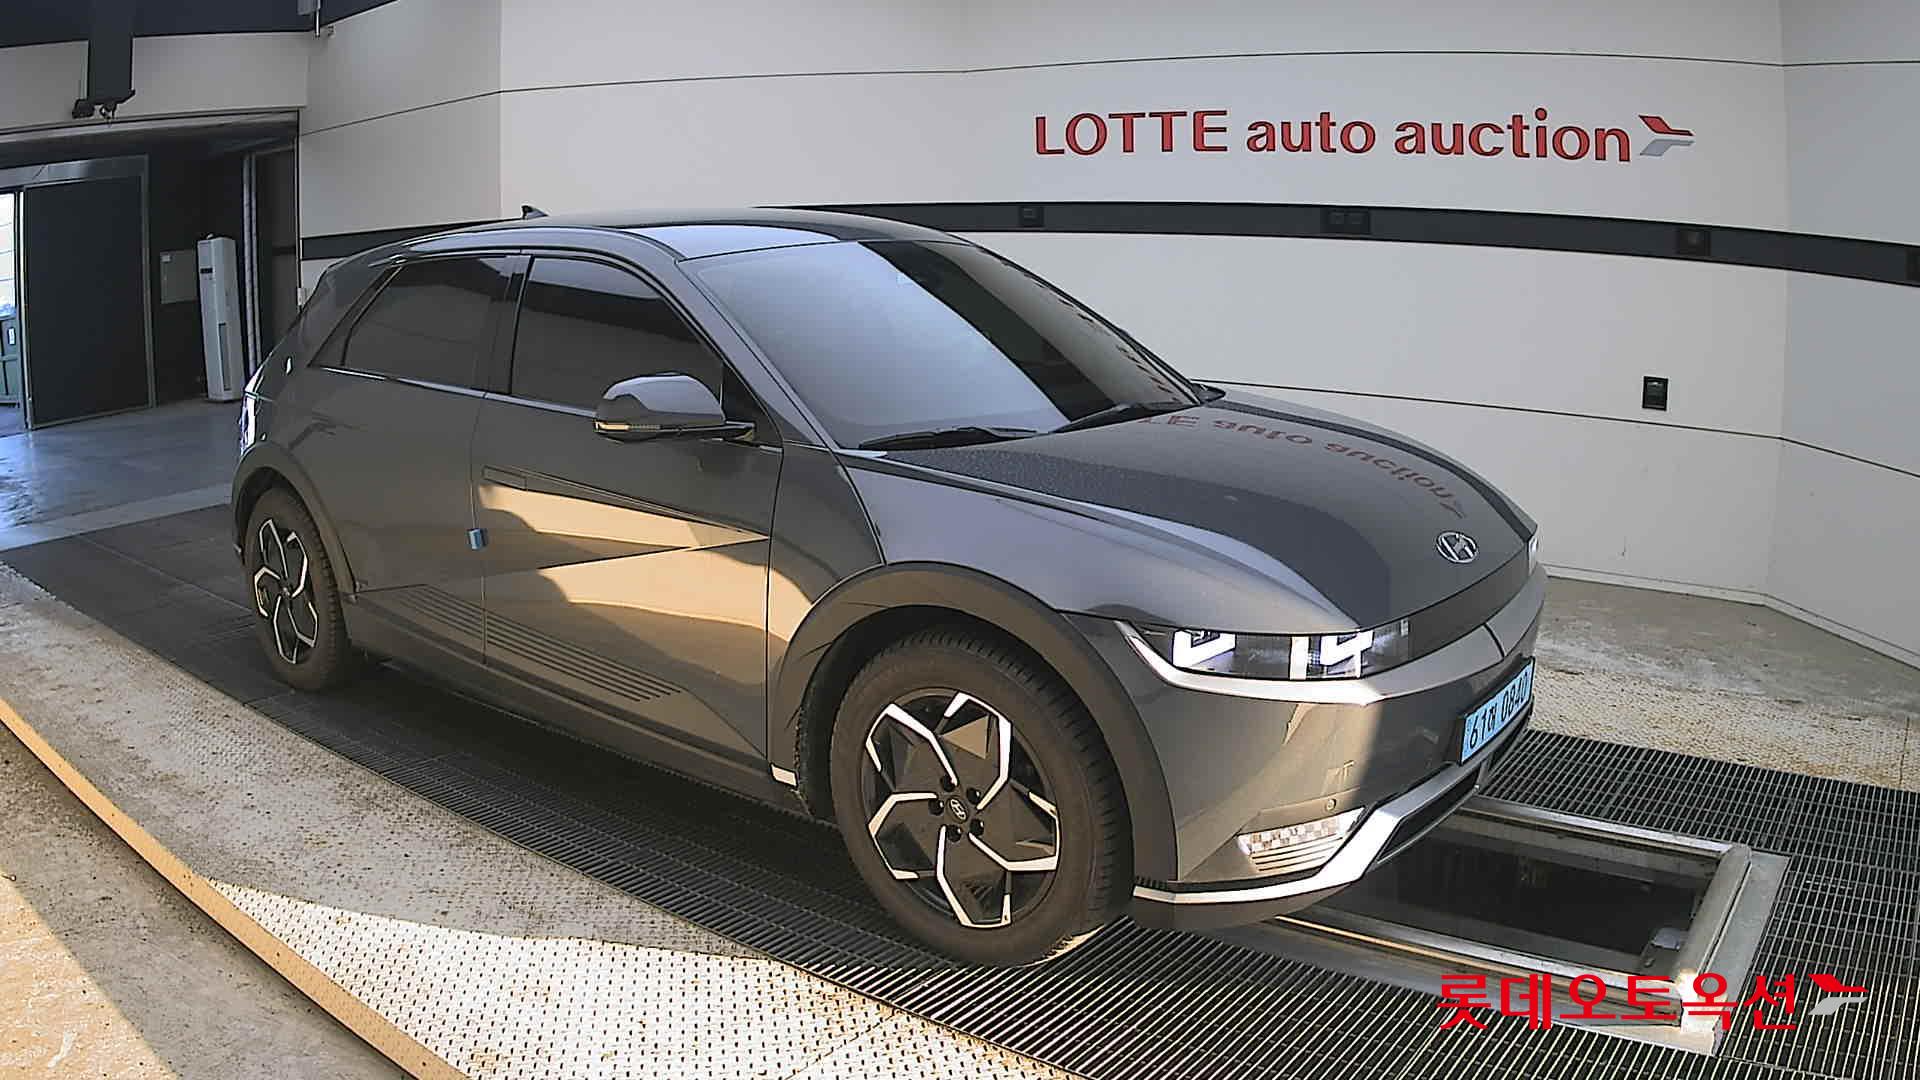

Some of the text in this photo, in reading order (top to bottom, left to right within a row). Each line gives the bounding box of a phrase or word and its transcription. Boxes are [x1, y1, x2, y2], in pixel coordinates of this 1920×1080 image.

[1035, 107, 1631, 163] LOTTE auto auction
